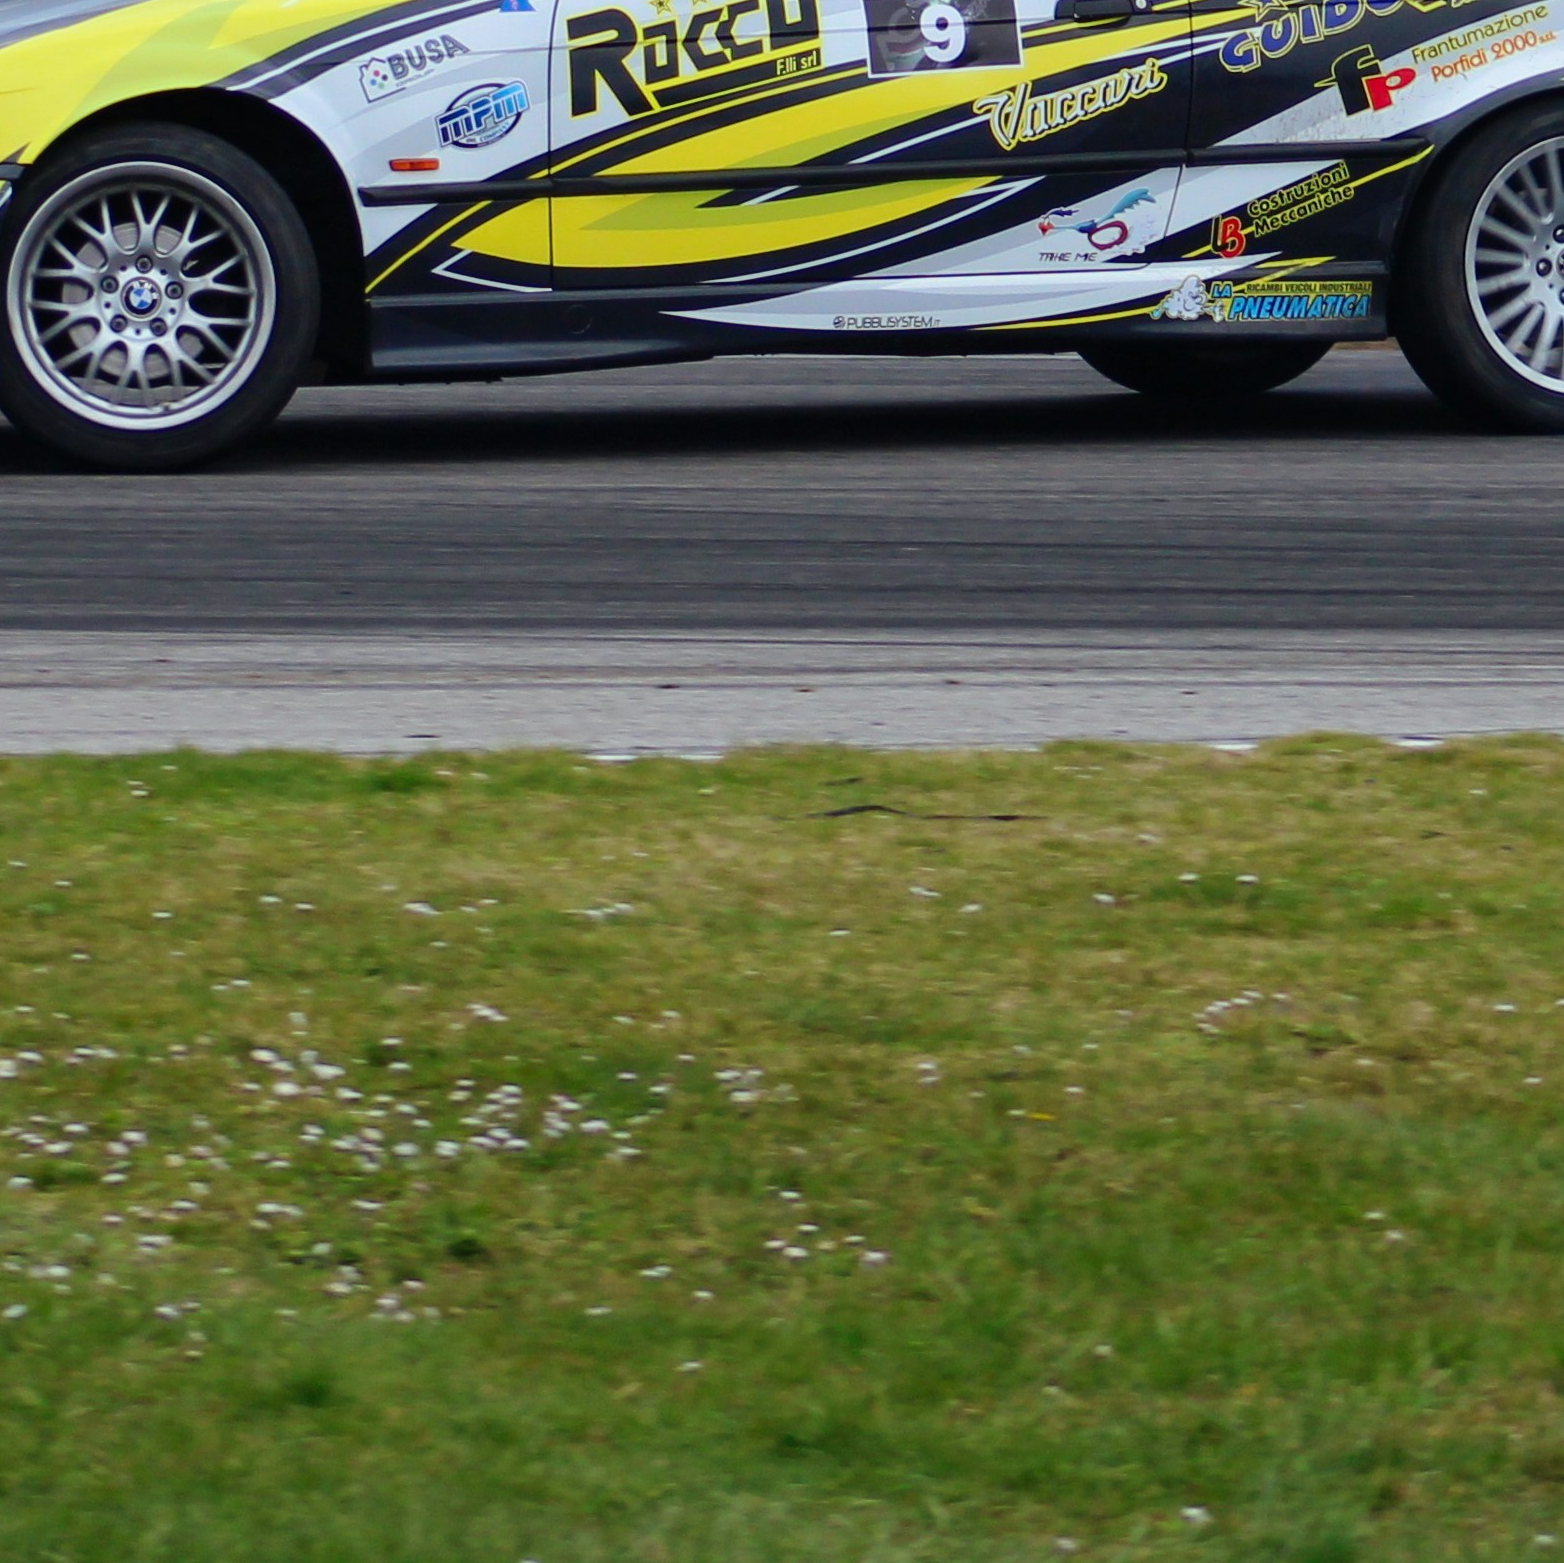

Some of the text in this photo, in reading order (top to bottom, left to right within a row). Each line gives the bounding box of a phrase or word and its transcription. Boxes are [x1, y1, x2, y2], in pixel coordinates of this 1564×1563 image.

[920, 4, 966, 62] 9
[1411, 5, 1549, 64] Frantumazione
[387, 35, 471, 80] BUSA
[800, 50, 817, 69] srl
[1431, 48, 1488, 82] Porfidi
[1491, 30, 1538, 60] 2000
[1248, 162, 1349, 217] Costruzioni
[1253, 186, 1354, 237] Meccaniche
[1074, 252, 1098, 262] ME
[1212, 282, 1233, 298] LA
[1227, 294, 1372, 321] PNEUMATICA
[1285, 282, 1317, 292] VEICOLI
[1319, 282, 1371, 293] INDUSTRIALI
